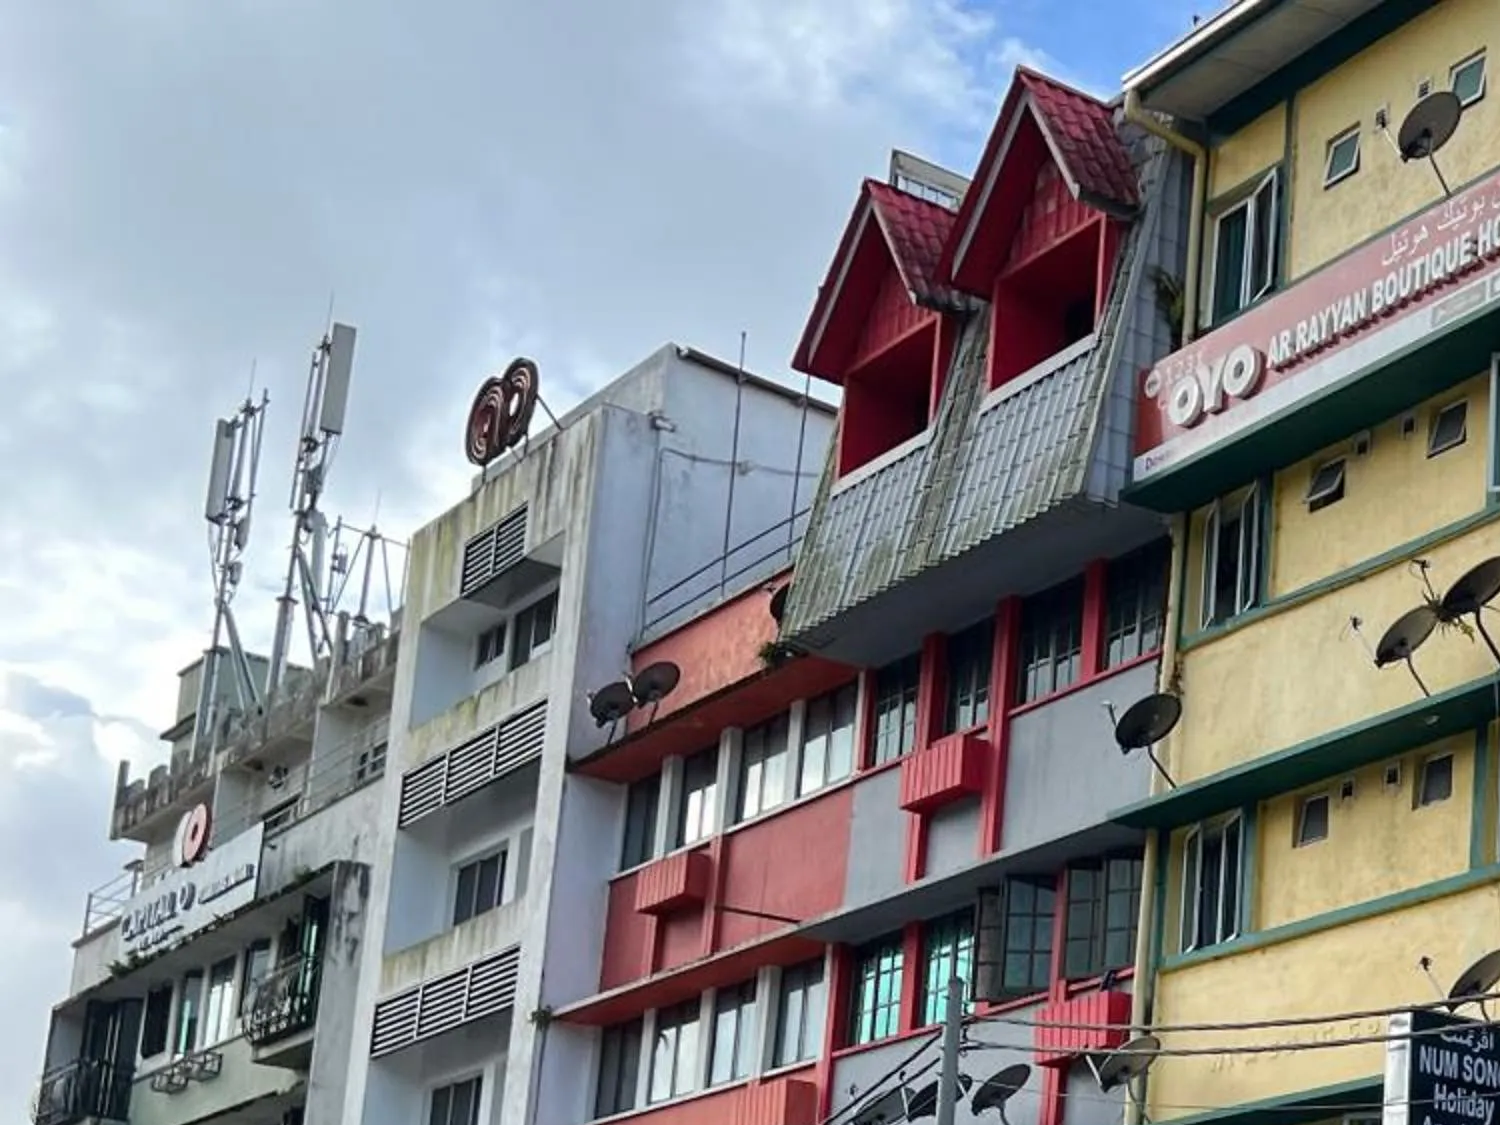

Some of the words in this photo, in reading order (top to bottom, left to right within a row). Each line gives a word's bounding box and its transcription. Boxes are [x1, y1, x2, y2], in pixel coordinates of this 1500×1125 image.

[1168, 344, 1259, 426] OYO
[1266, 331, 1291, 369] AR
[1296, 288, 1368, 350] RAYYAN
[1372, 231, 1472, 313] BOUTIQUE
[1420, 1044, 1459, 1080] NUM
